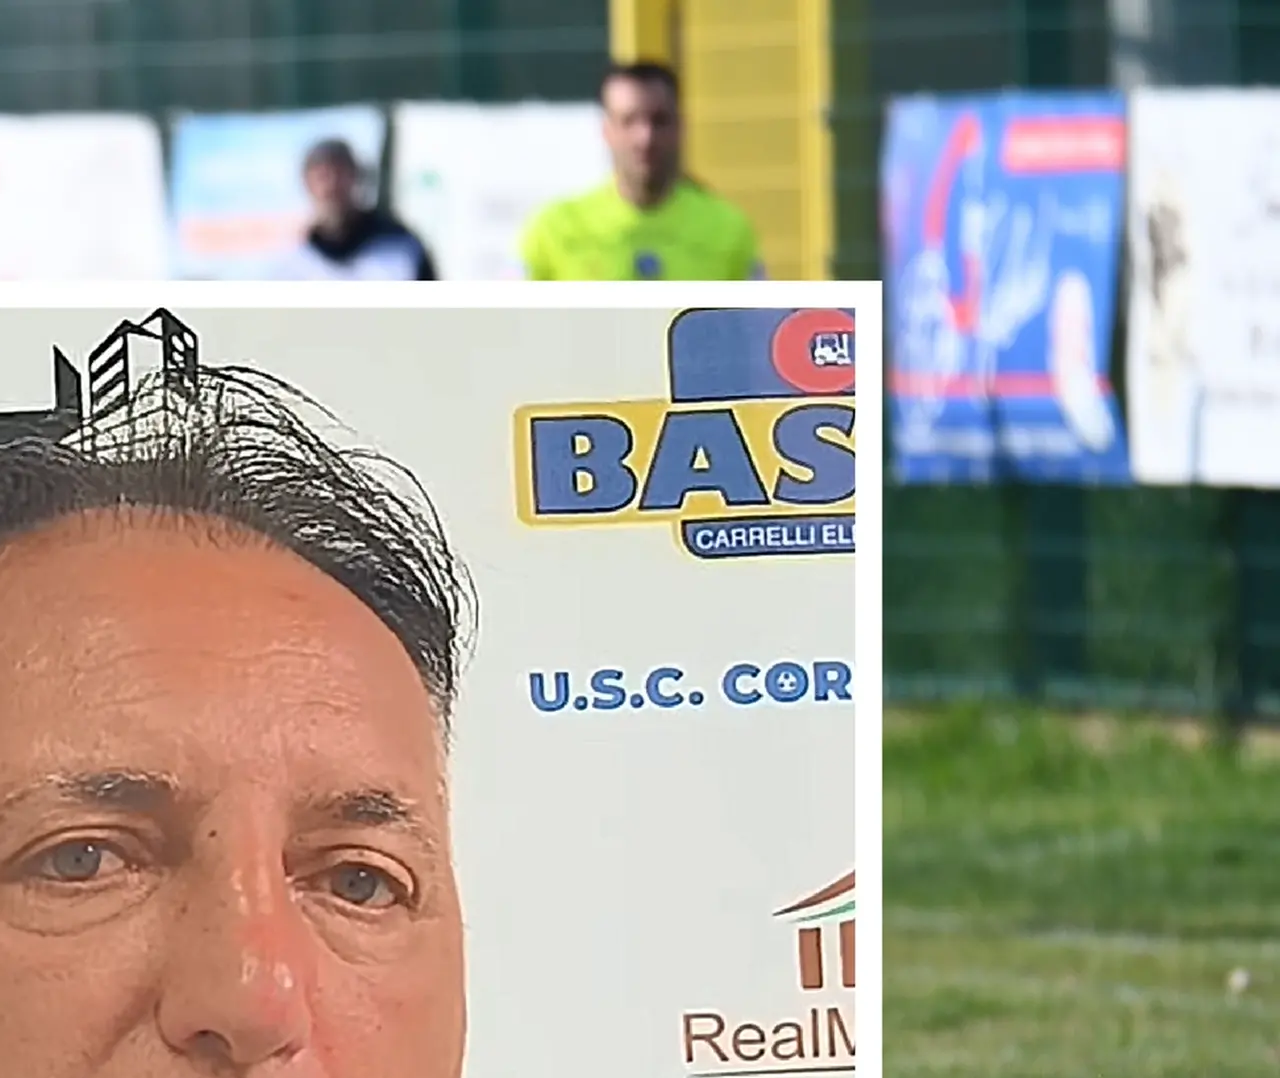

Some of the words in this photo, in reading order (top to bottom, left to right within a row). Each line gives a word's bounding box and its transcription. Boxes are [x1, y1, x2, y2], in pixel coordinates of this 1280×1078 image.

[531, 403, 855, 515] BAS
[696, 526, 815, 550] CARRELLI
[822, 524, 855, 545] EL
[529, 667, 704, 711] U.S.C.
[722, 661, 852, 704] COR
